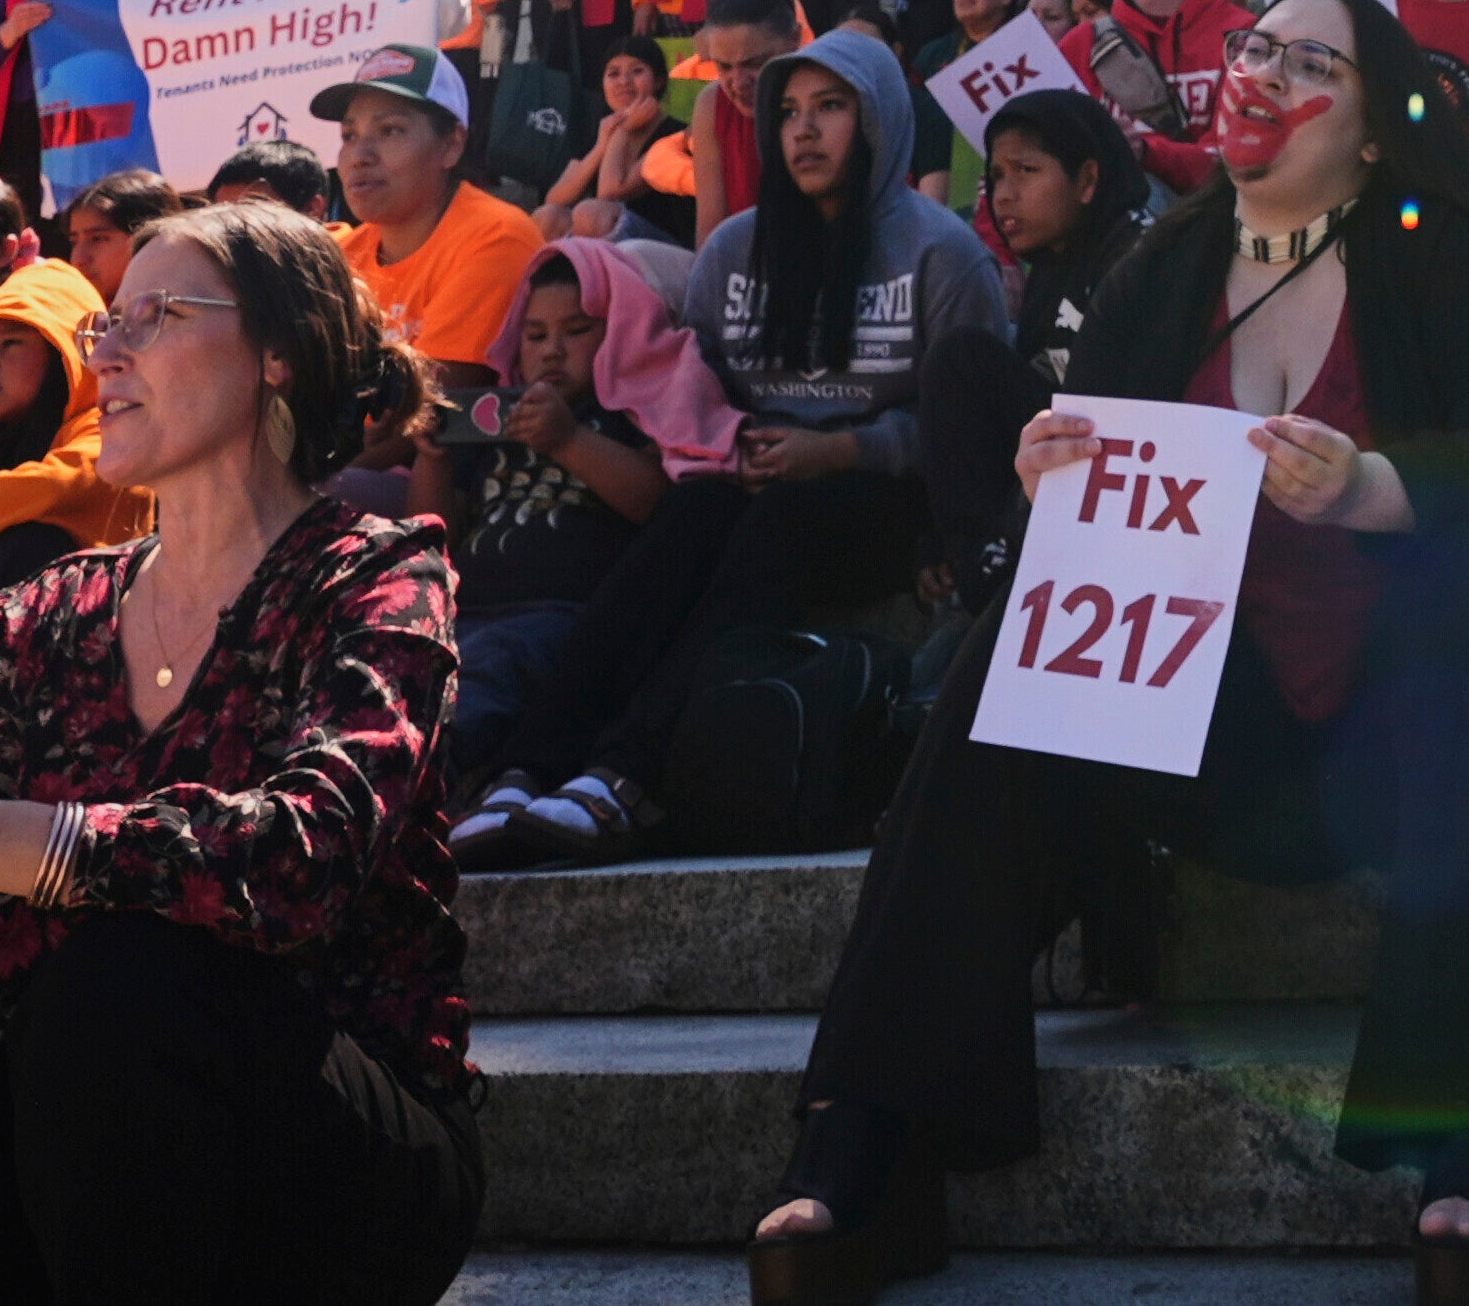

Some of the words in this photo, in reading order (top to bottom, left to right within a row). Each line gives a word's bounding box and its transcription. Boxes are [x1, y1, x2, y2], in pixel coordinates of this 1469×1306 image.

[142, 23, 257, 71] Damn
[268, 1, 378, 48] High!
[156, 79, 217, 101] Tenants
[219, 69, 260, 89] Need
[262, 53, 346, 81] Protection
[959, 52, 1042, 114] Fix
[749, 382, 875, 400] WASHINGTON
[1077, 436, 1207, 538] Fix
[1016, 578, 1226, 689] 1217
